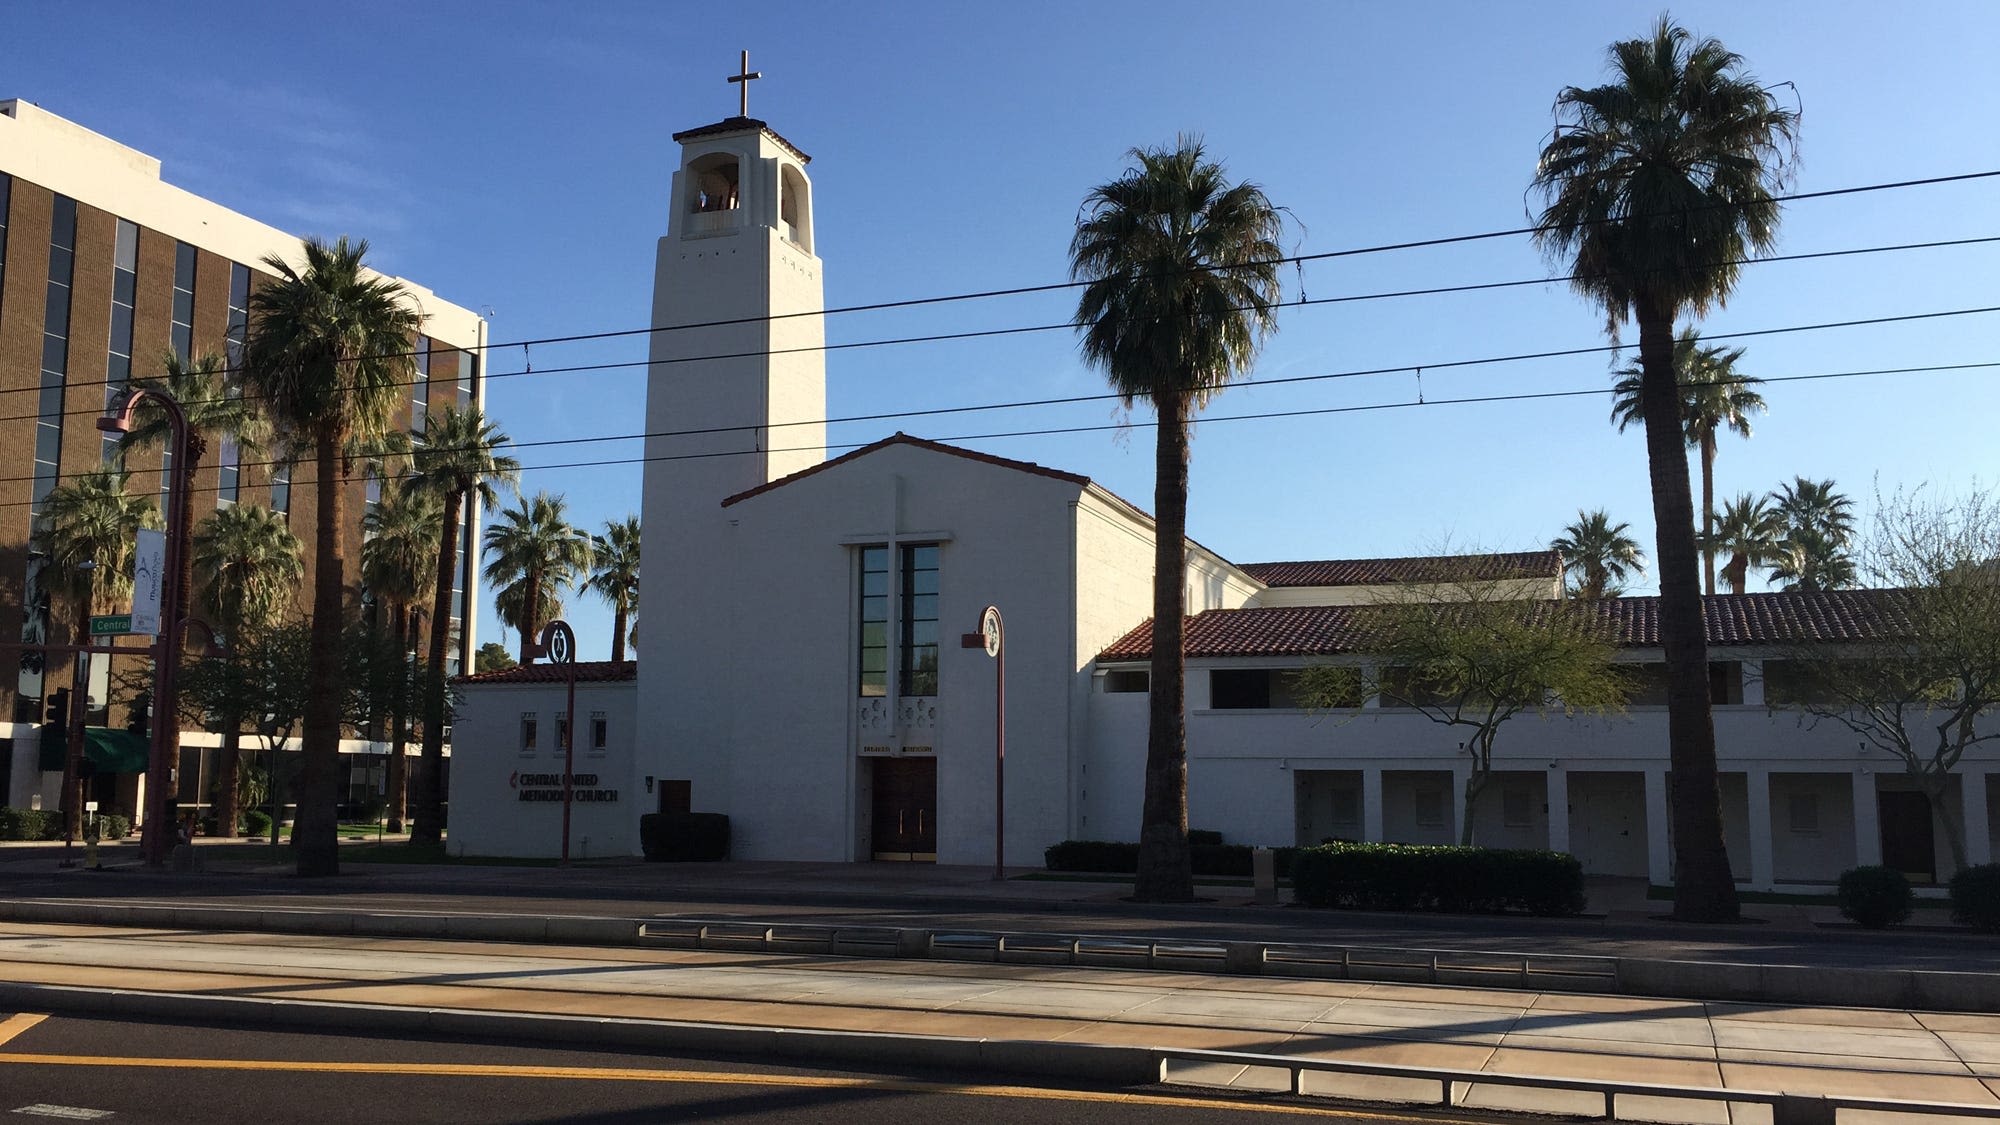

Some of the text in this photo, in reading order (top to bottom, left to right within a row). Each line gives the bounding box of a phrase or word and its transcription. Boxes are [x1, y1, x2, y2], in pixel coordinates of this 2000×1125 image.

[97, 619, 130, 631] Central
[519, 774, 560, 785] CENTRAL
[518, 789, 618, 801] METHODIT CHURCH
